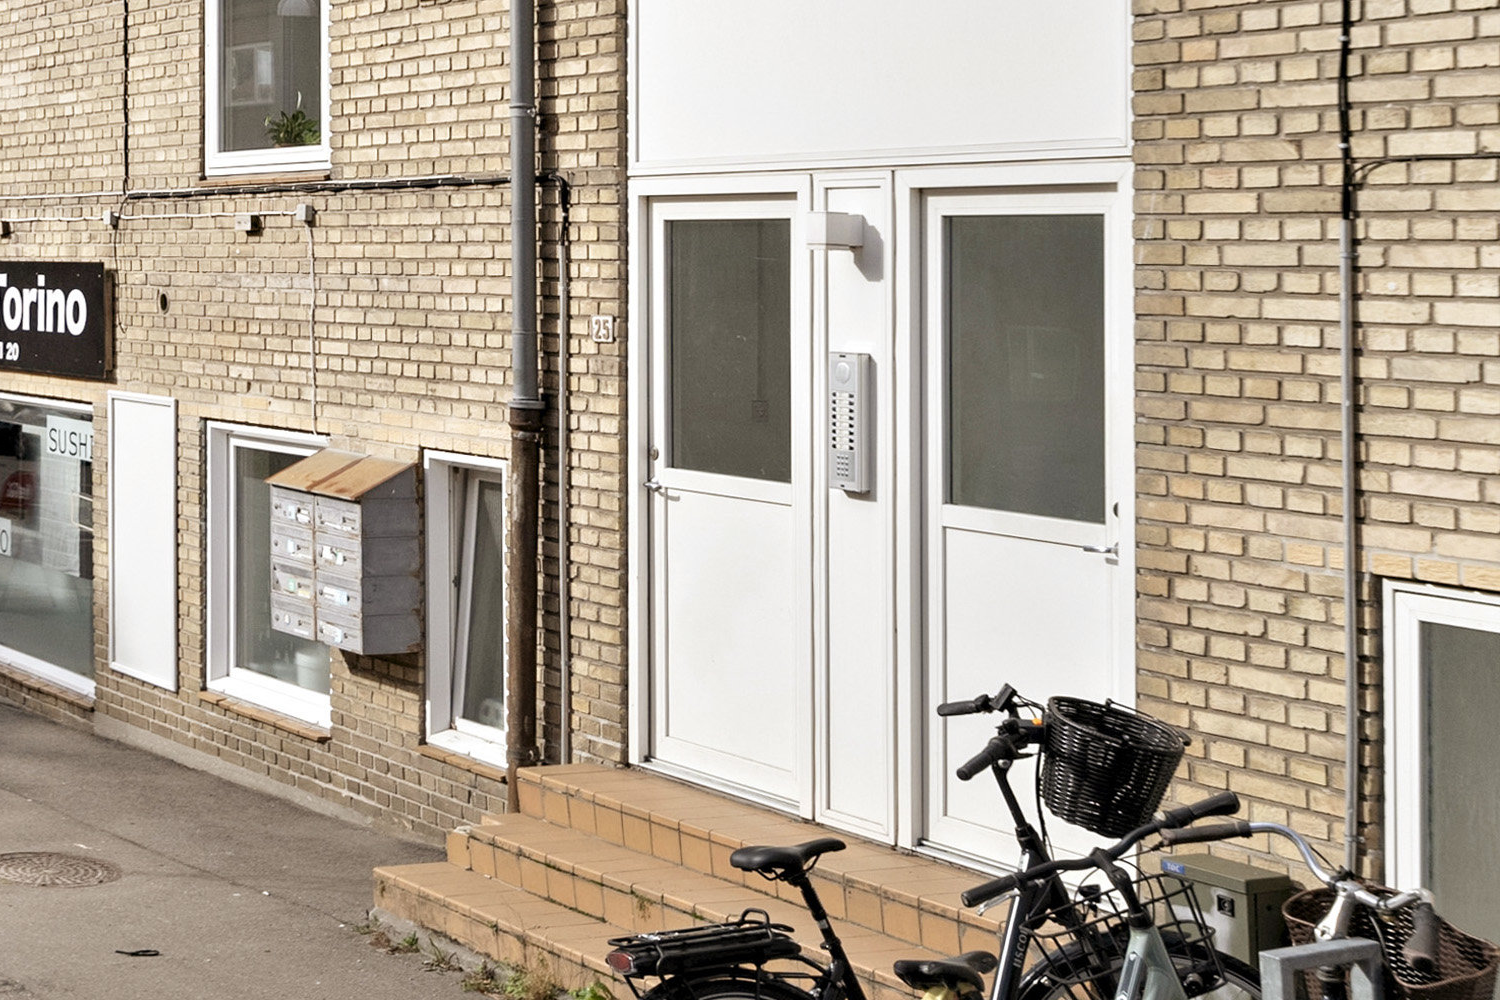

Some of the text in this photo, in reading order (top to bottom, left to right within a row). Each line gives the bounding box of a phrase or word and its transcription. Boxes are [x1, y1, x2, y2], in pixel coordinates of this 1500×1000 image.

[594, 318, 610, 341] 25
[5, 341, 20, 361] 20
[49, 427, 93, 460] SUSHI
